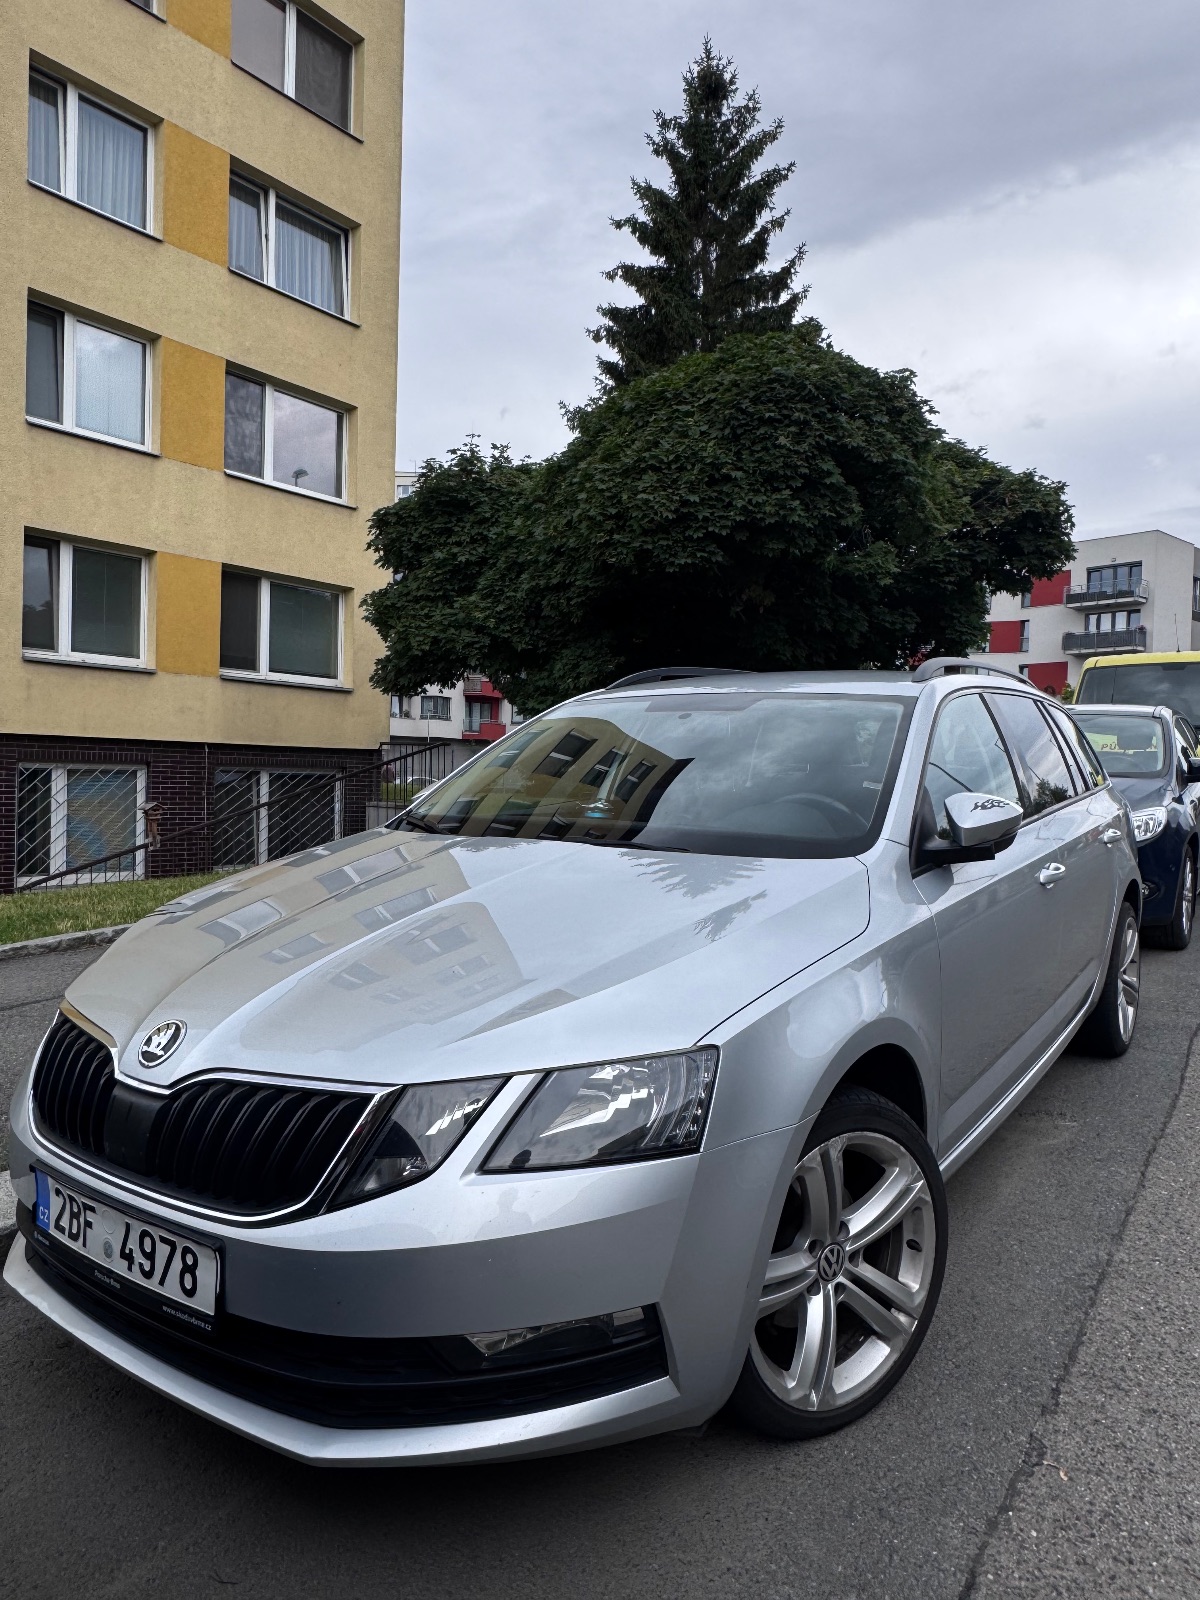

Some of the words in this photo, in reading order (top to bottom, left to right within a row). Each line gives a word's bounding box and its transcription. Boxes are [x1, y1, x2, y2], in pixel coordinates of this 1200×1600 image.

[39, 1206, 49, 1223] CZ
[53, 1186, 97, 1249] 2BF
[119, 1220, 199, 1299] 4978
